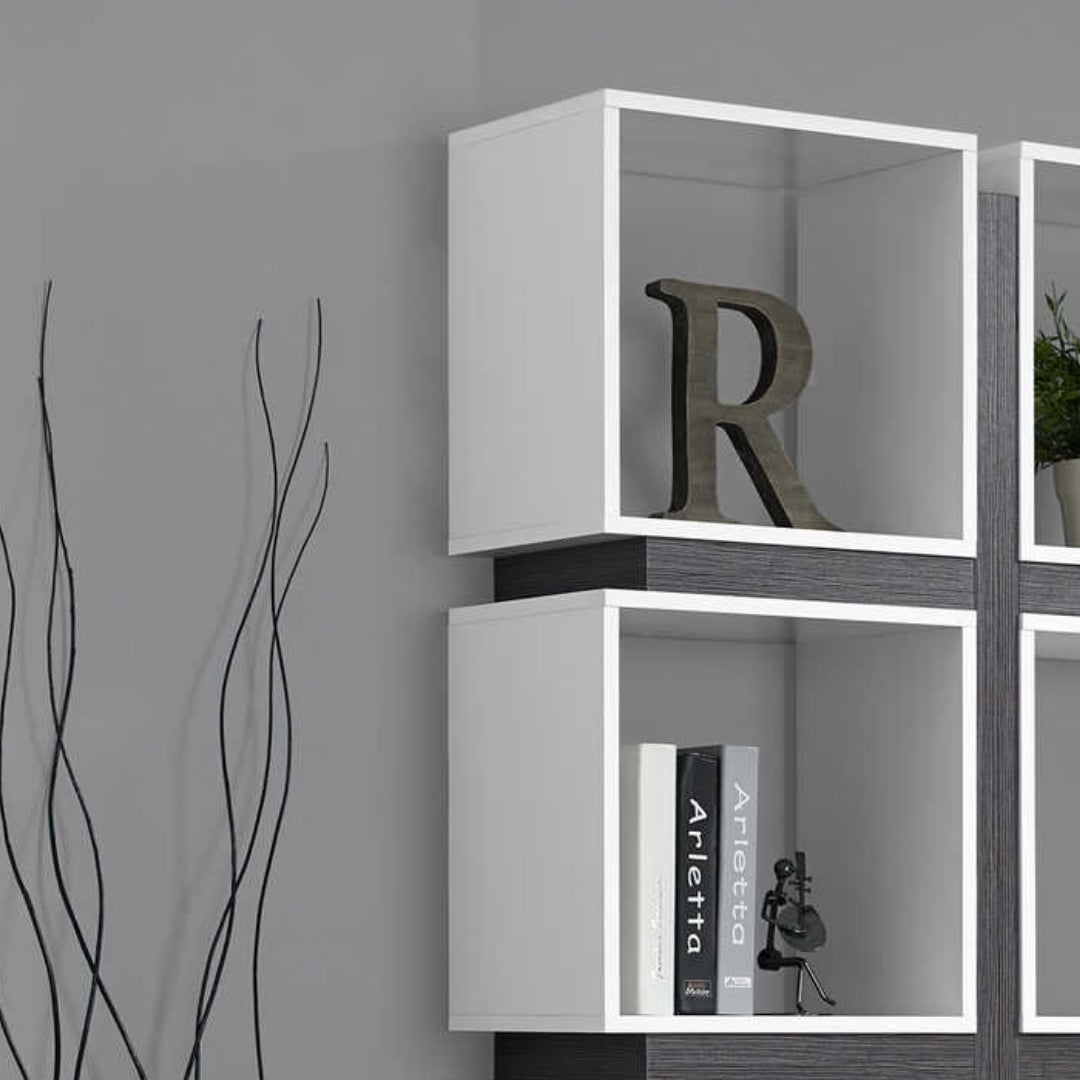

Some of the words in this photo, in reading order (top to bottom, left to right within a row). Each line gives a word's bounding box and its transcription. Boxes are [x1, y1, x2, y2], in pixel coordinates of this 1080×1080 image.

[645, 278, 845, 532] R
[687, 798, 708, 954] Arletta
[731, 782, 750, 946] Arletta
